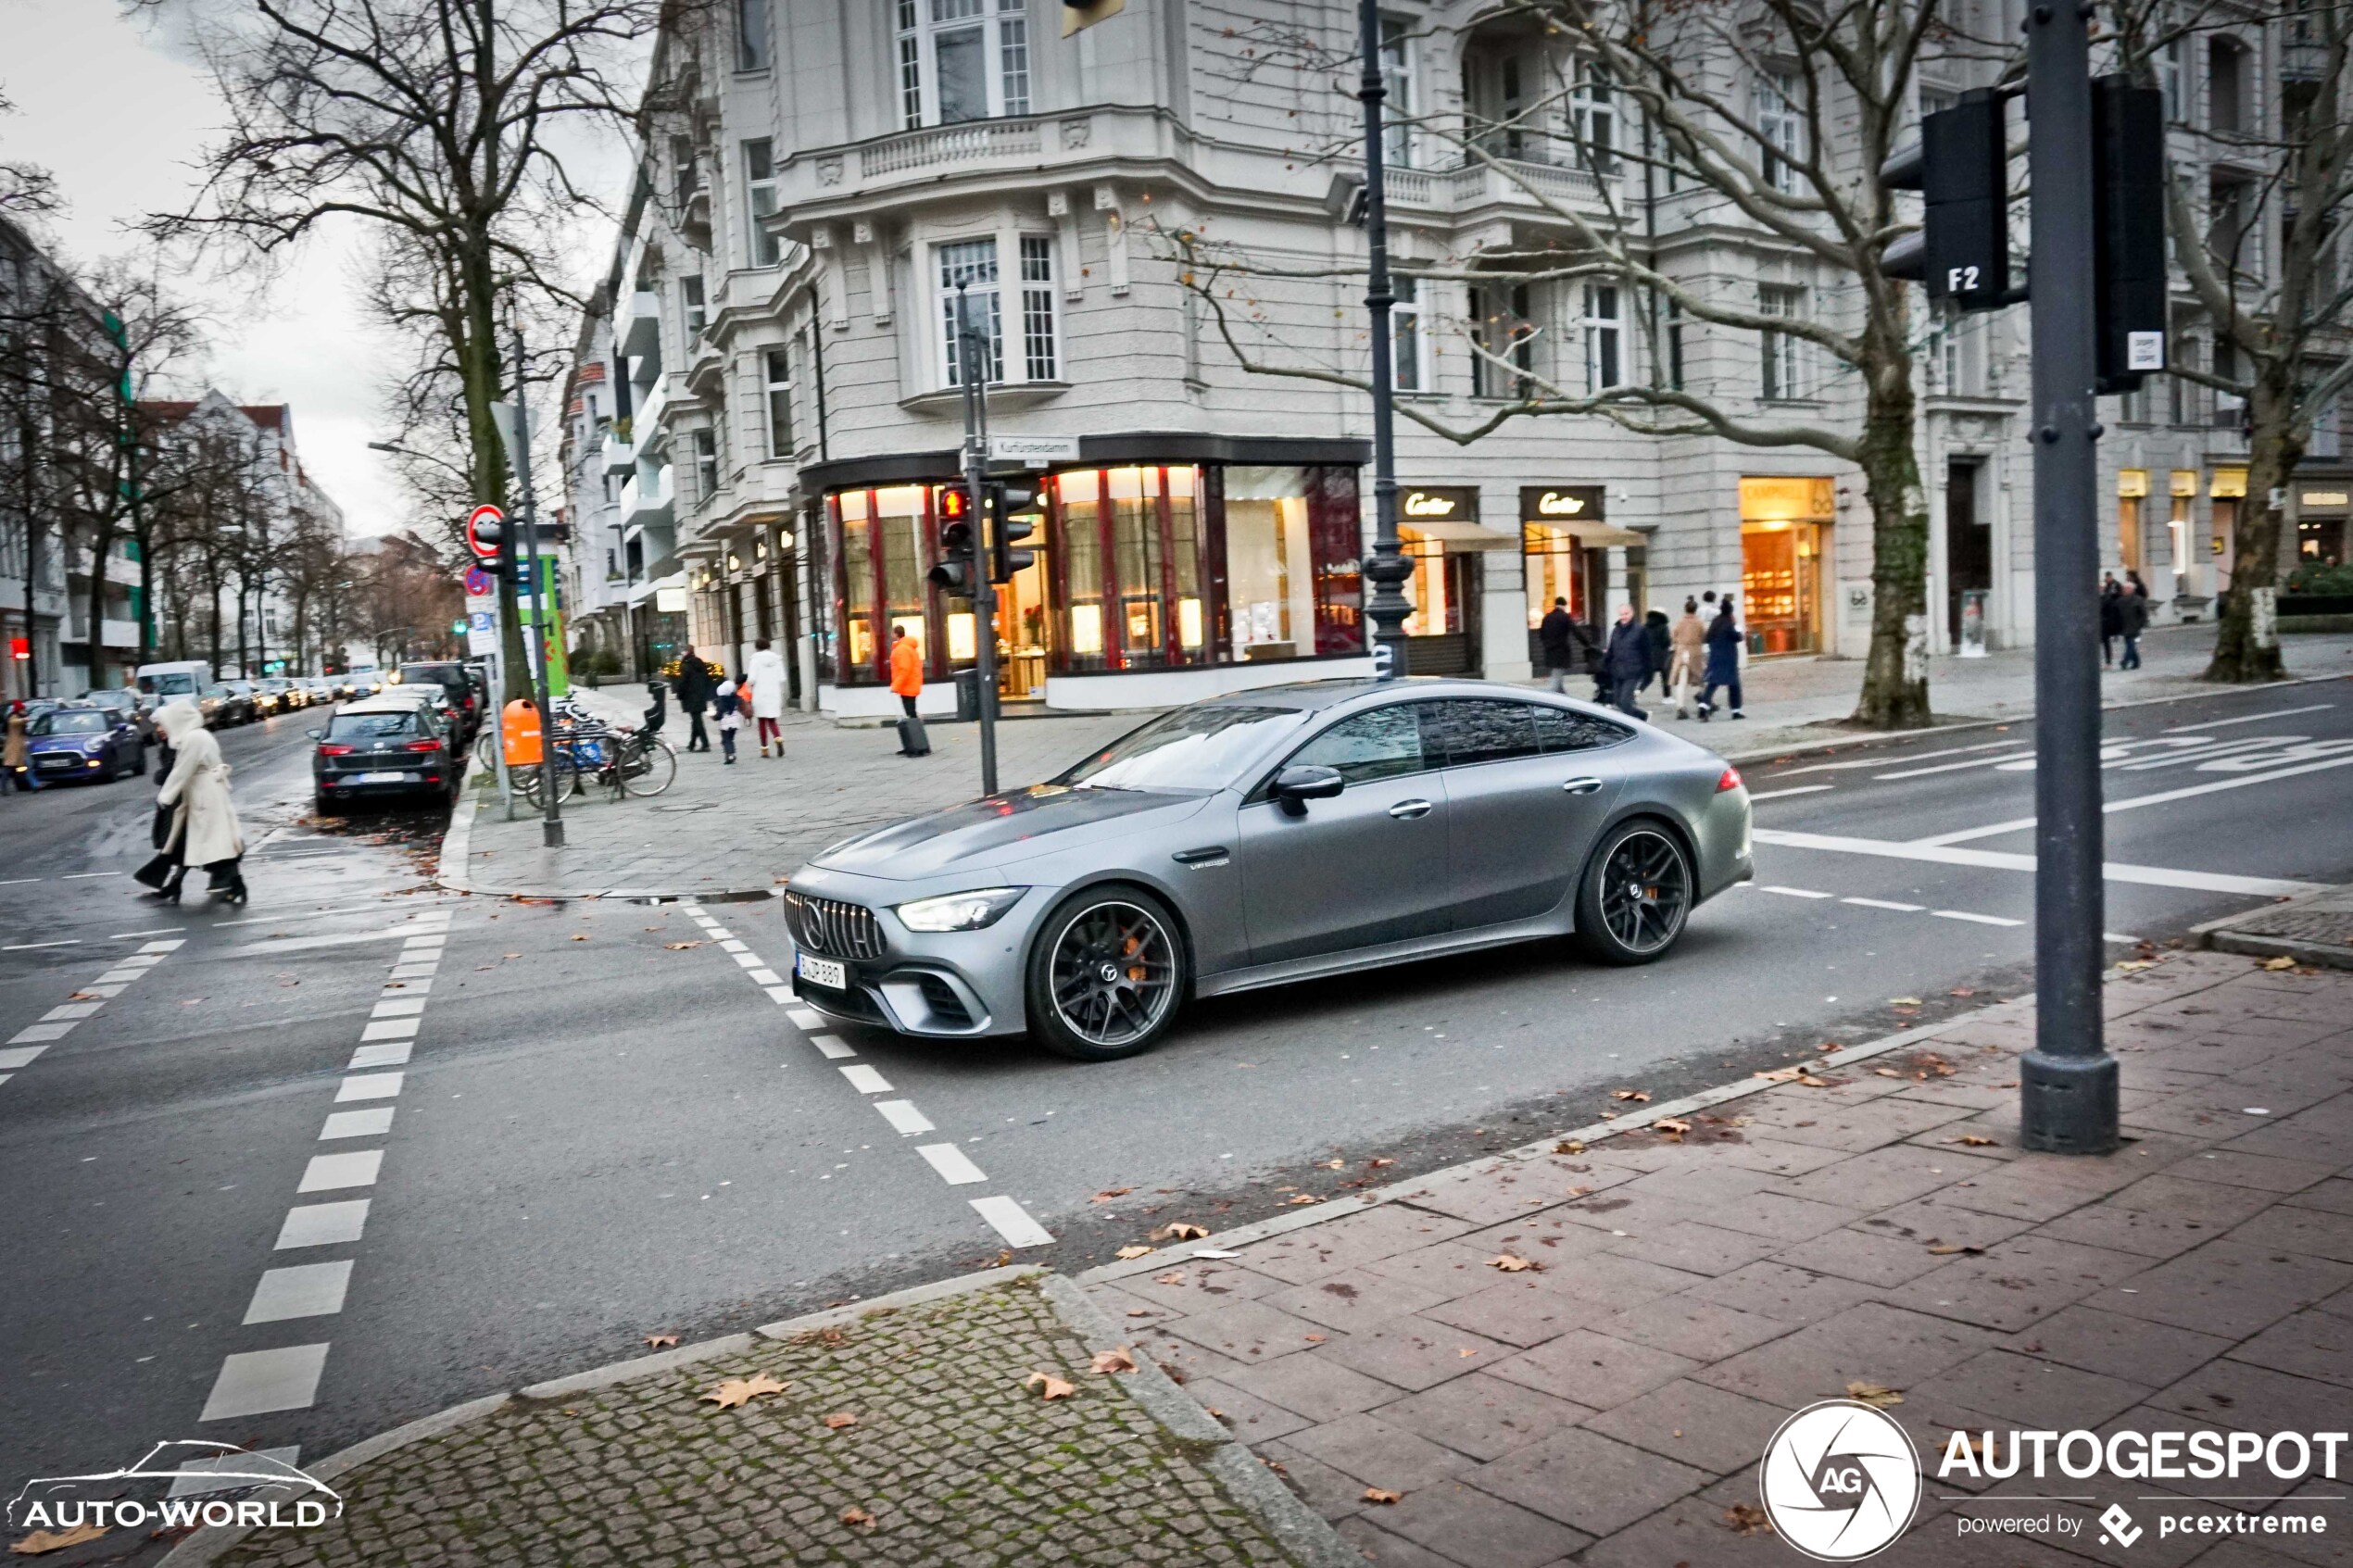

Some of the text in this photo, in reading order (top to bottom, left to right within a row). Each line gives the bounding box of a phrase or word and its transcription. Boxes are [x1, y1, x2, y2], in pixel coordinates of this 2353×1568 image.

[1948, 266, 1980, 292] F2
[1405, 492, 1455, 516] Cartier
[1539, 492, 1585, 515] Cartier
